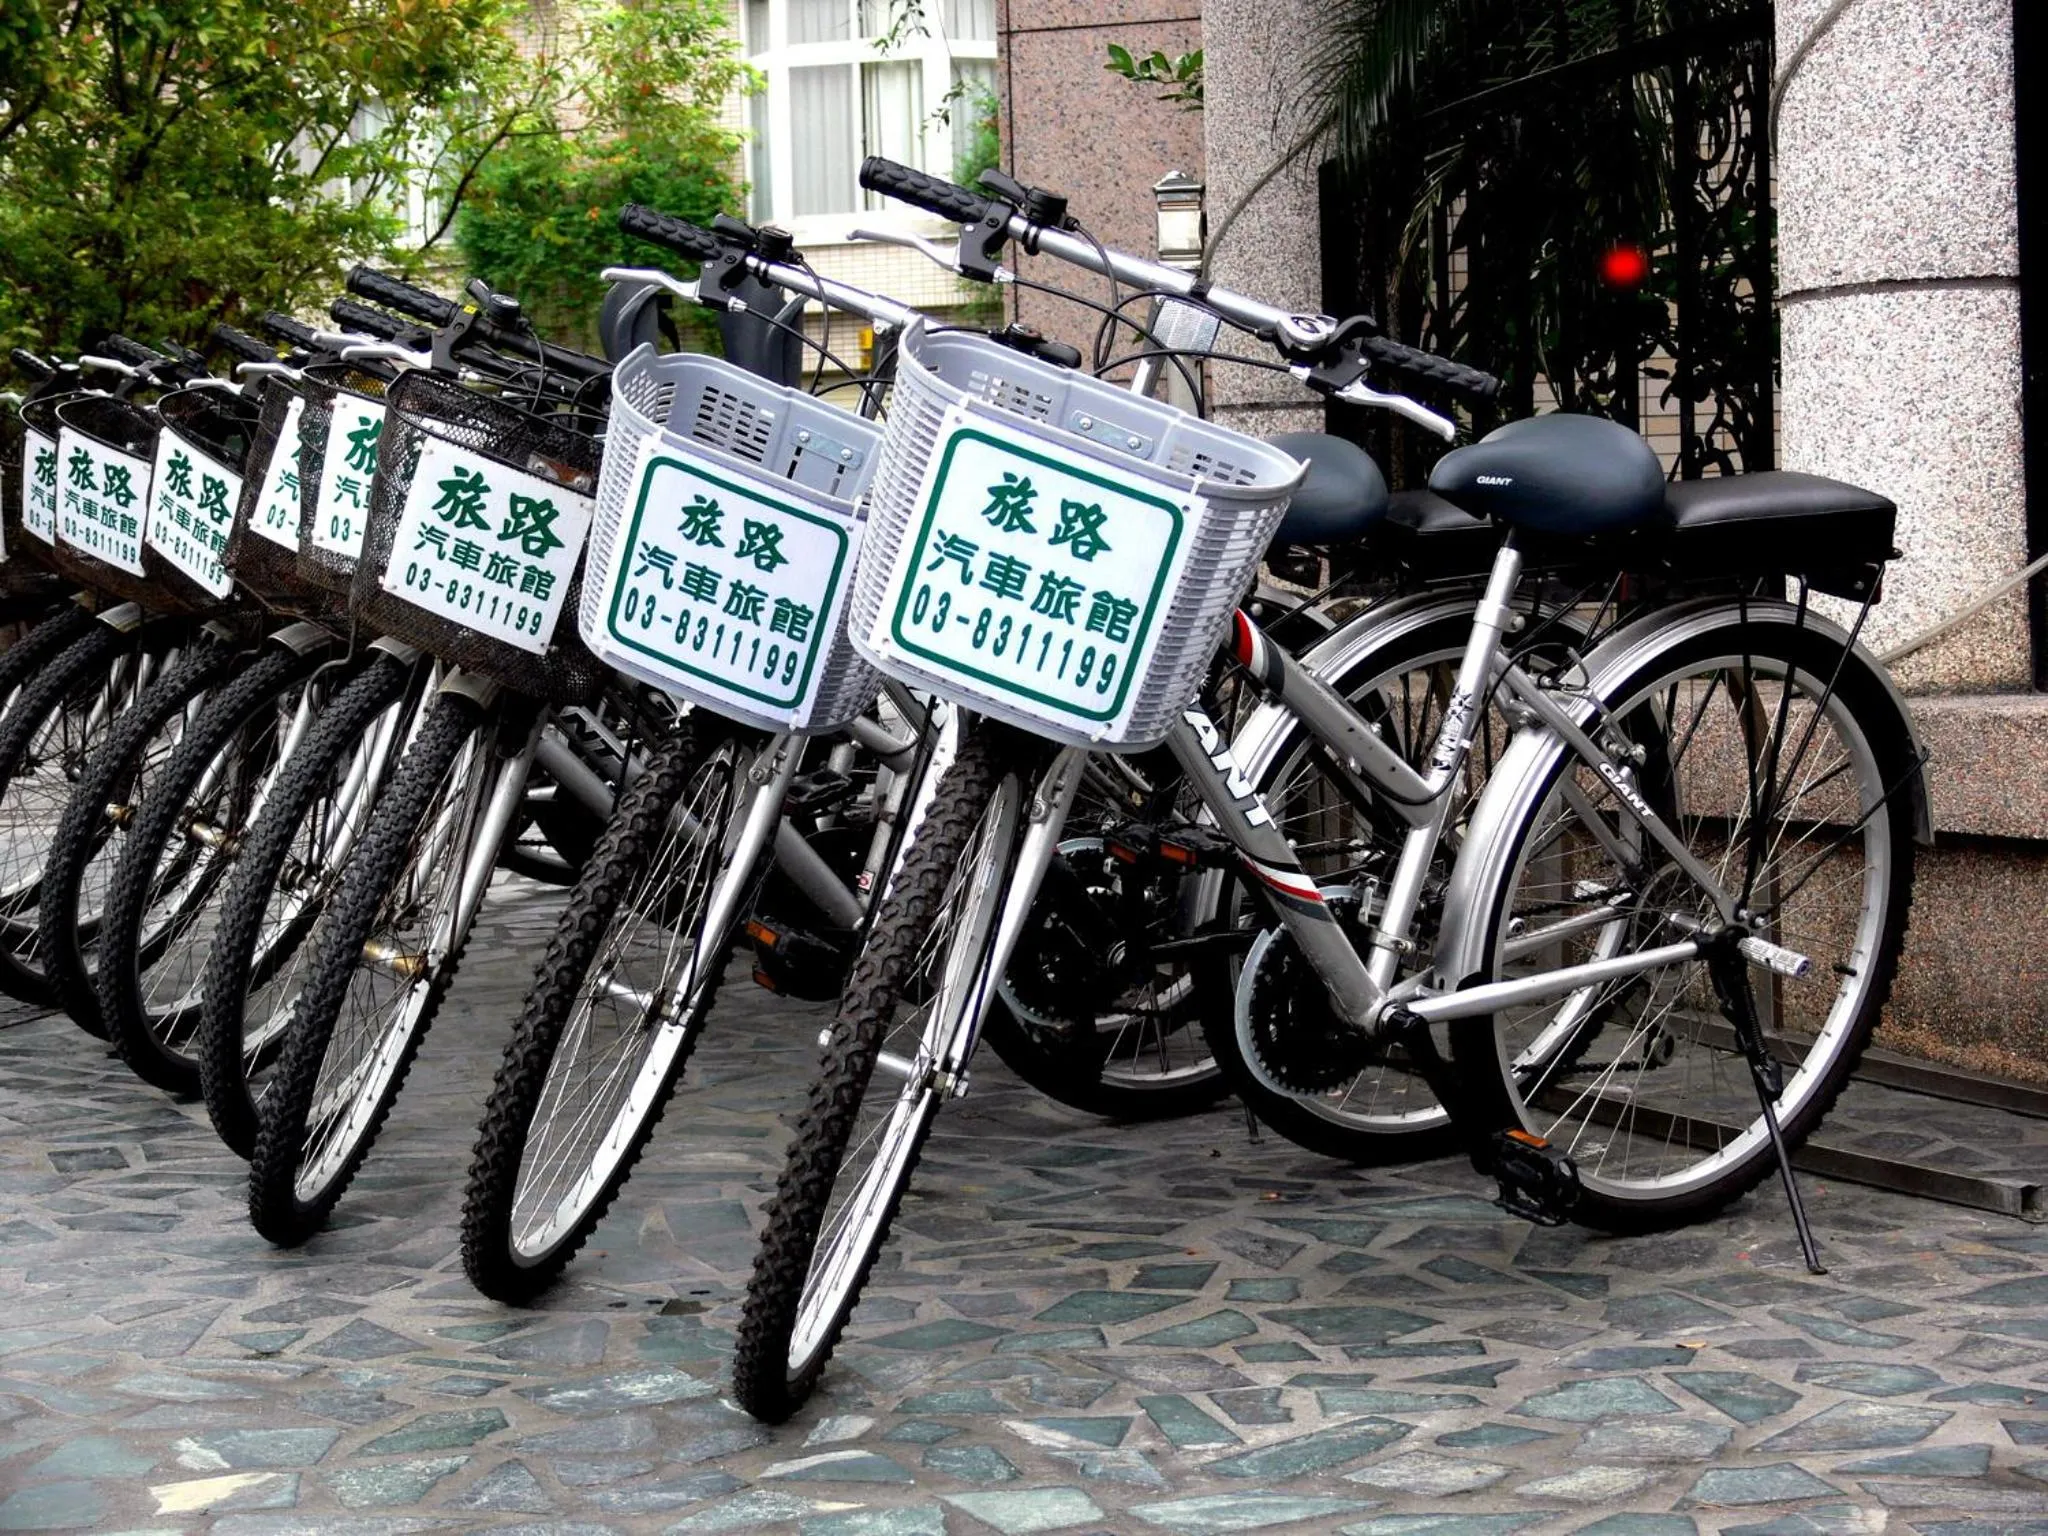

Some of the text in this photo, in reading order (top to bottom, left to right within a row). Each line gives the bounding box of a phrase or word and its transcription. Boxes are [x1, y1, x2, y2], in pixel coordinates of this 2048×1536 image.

[64, 488, 138, 538] 汽車旅館
[68, 446, 138, 508] 旅路
[165, 449, 232, 525] 旅路
[432, 466, 563, 558] 旅路
[1476, 475, 1513, 486] GIANT
[64, 517, 137, 564] 03-8311199
[678, 495, 789, 573] 旅路
[981, 471, 1112, 562] 旅路
[406, 562, 543, 635] 03-8311199
[414, 522, 557, 601] 汽車旅館
[634, 542, 814, 644] 汽車旅館
[926, 529, 1139, 645] 汽車旅館
[625, 588, 799, 686] 03-8311199
[912, 584, 1117, 695] 03-8311199
[1599, 762, 1654, 816] GIANT
